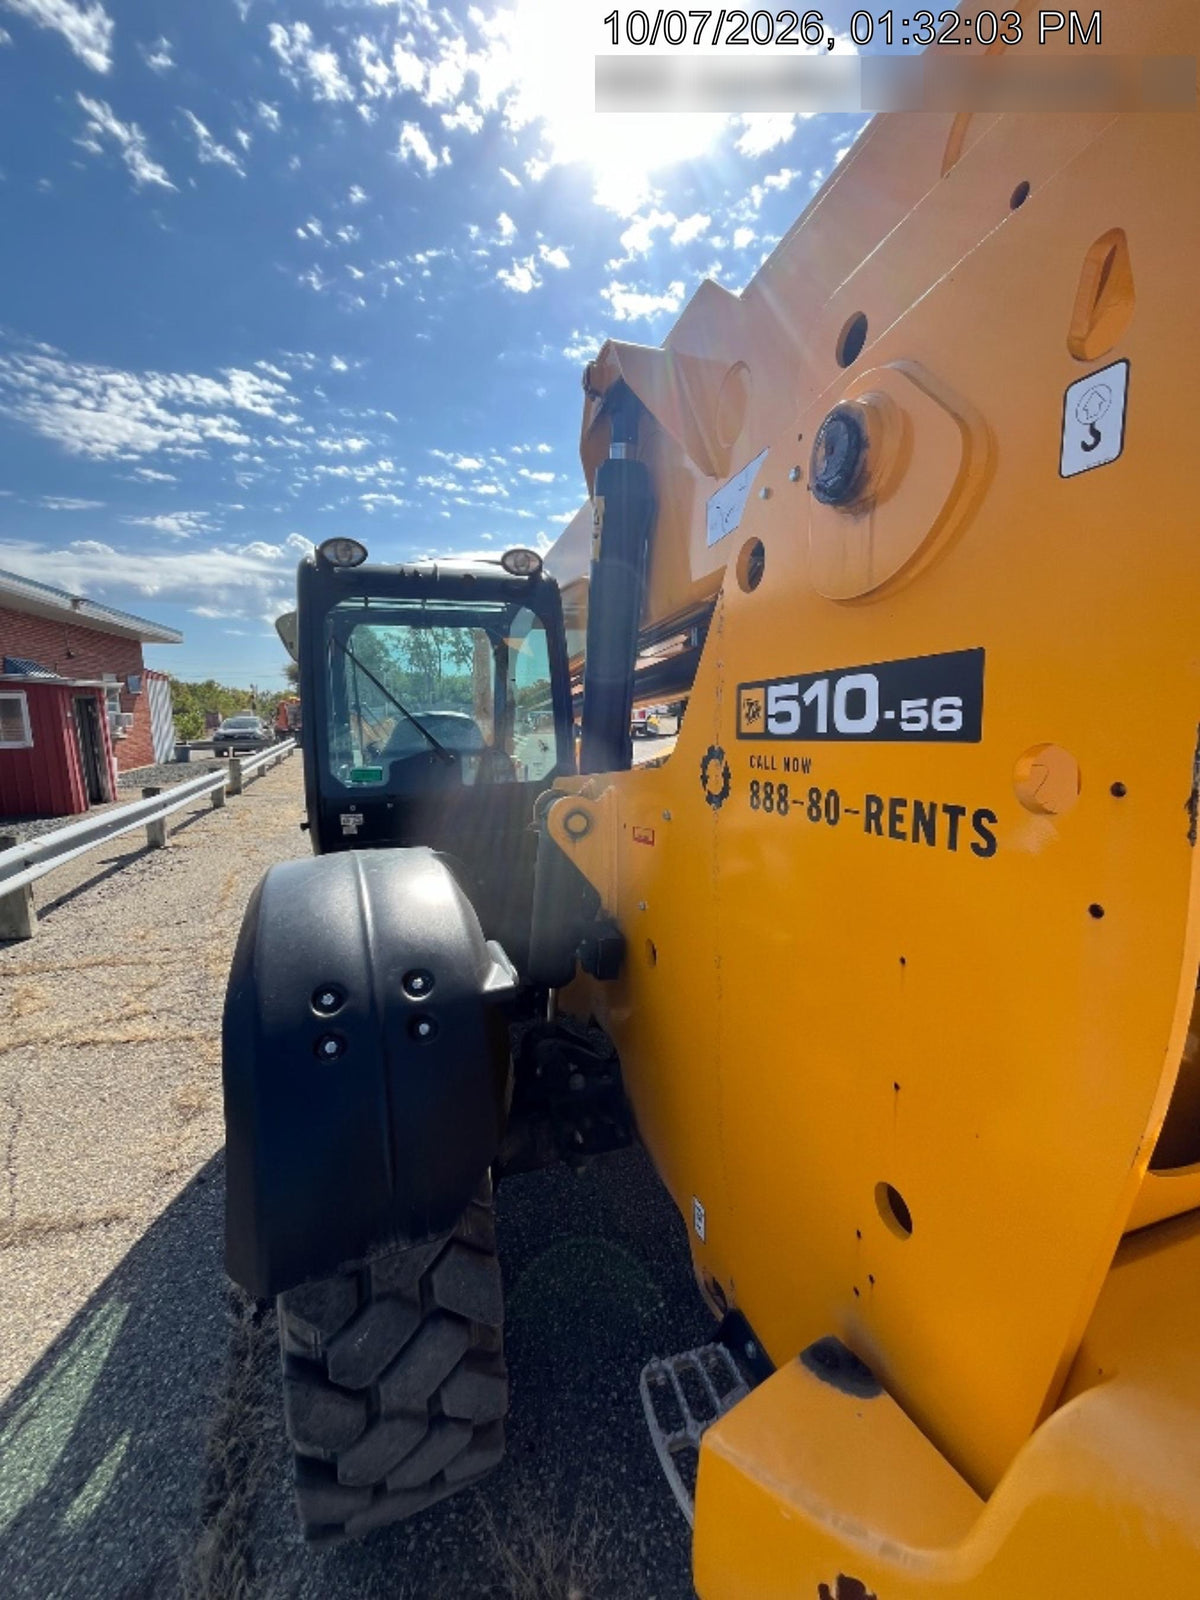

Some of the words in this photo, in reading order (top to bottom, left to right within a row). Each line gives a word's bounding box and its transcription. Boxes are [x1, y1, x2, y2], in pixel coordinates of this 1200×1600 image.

[749, 755, 778, 771] CALL
[783, 757, 812, 774] NOW
[750, 780, 998, 858] 888-80-RENTS
